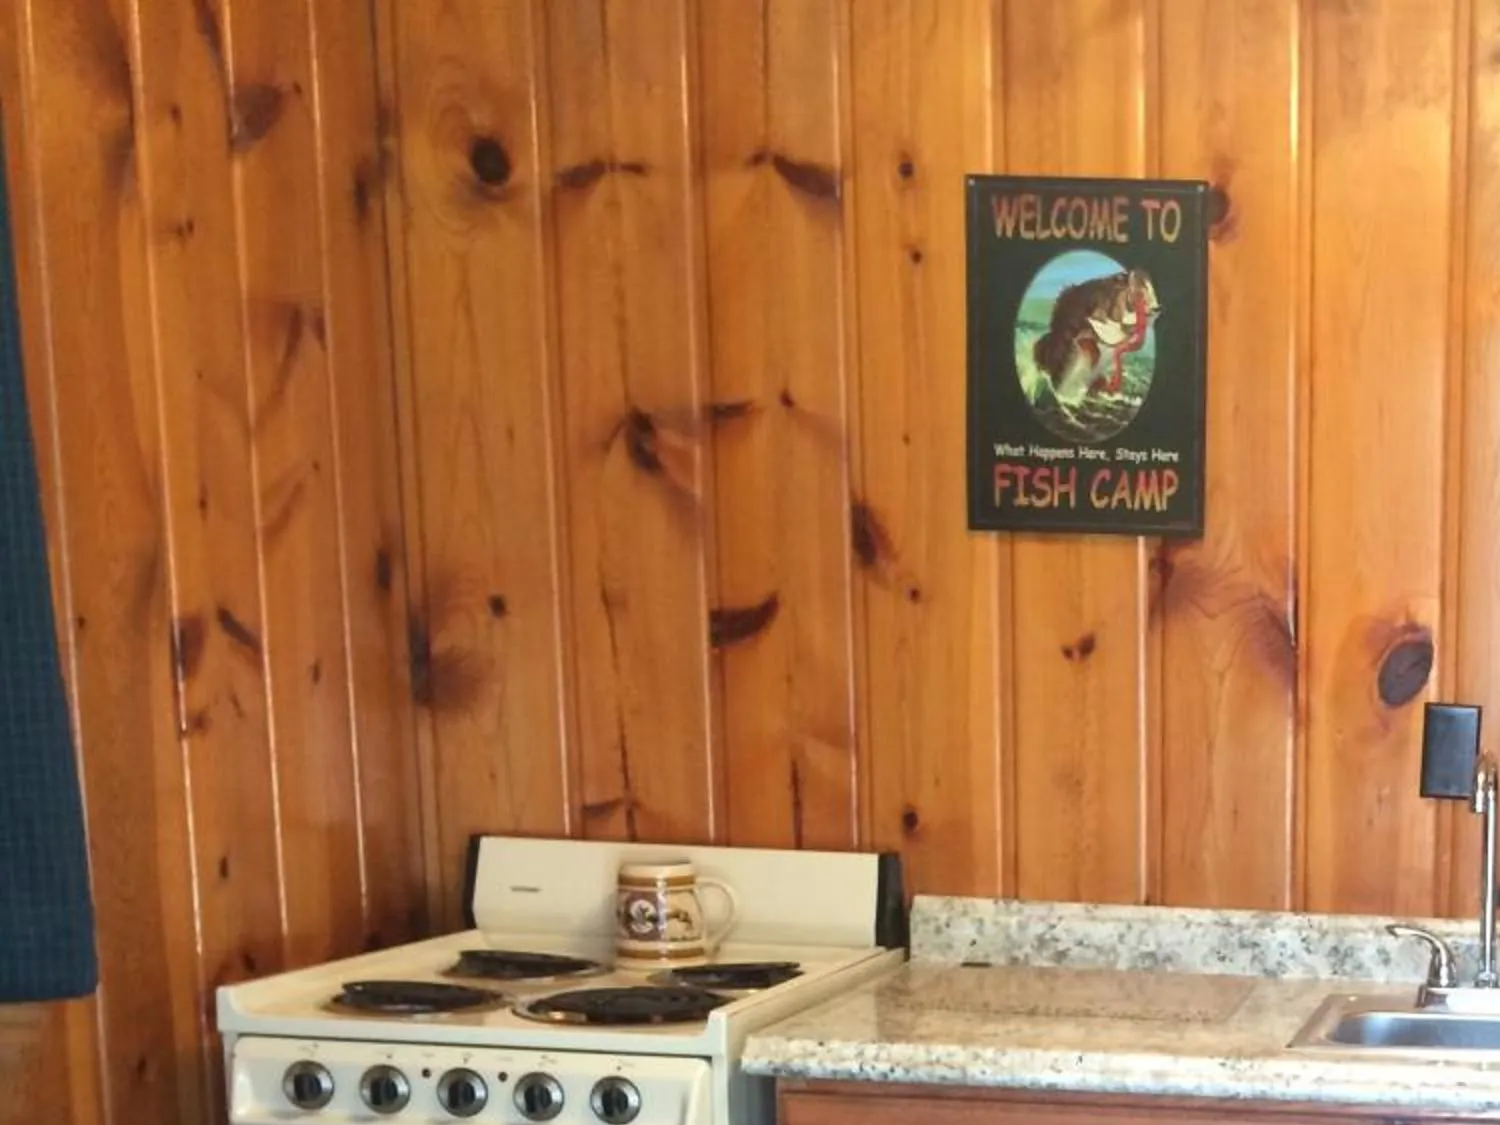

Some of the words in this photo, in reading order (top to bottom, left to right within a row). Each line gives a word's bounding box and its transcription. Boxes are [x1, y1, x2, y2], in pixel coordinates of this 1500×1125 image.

[991, 193, 1129, 243] WELCOME
[1140, 198, 1181, 243] TO
[993, 443, 1025, 457] What
[1028, 445, 1075, 461] Happens
[1115, 447, 1148, 464] Stays
[1151, 448, 1180, 463] Here
[993, 464, 1077, 509] FISH
[1089, 467, 1180, 512] CAMP
